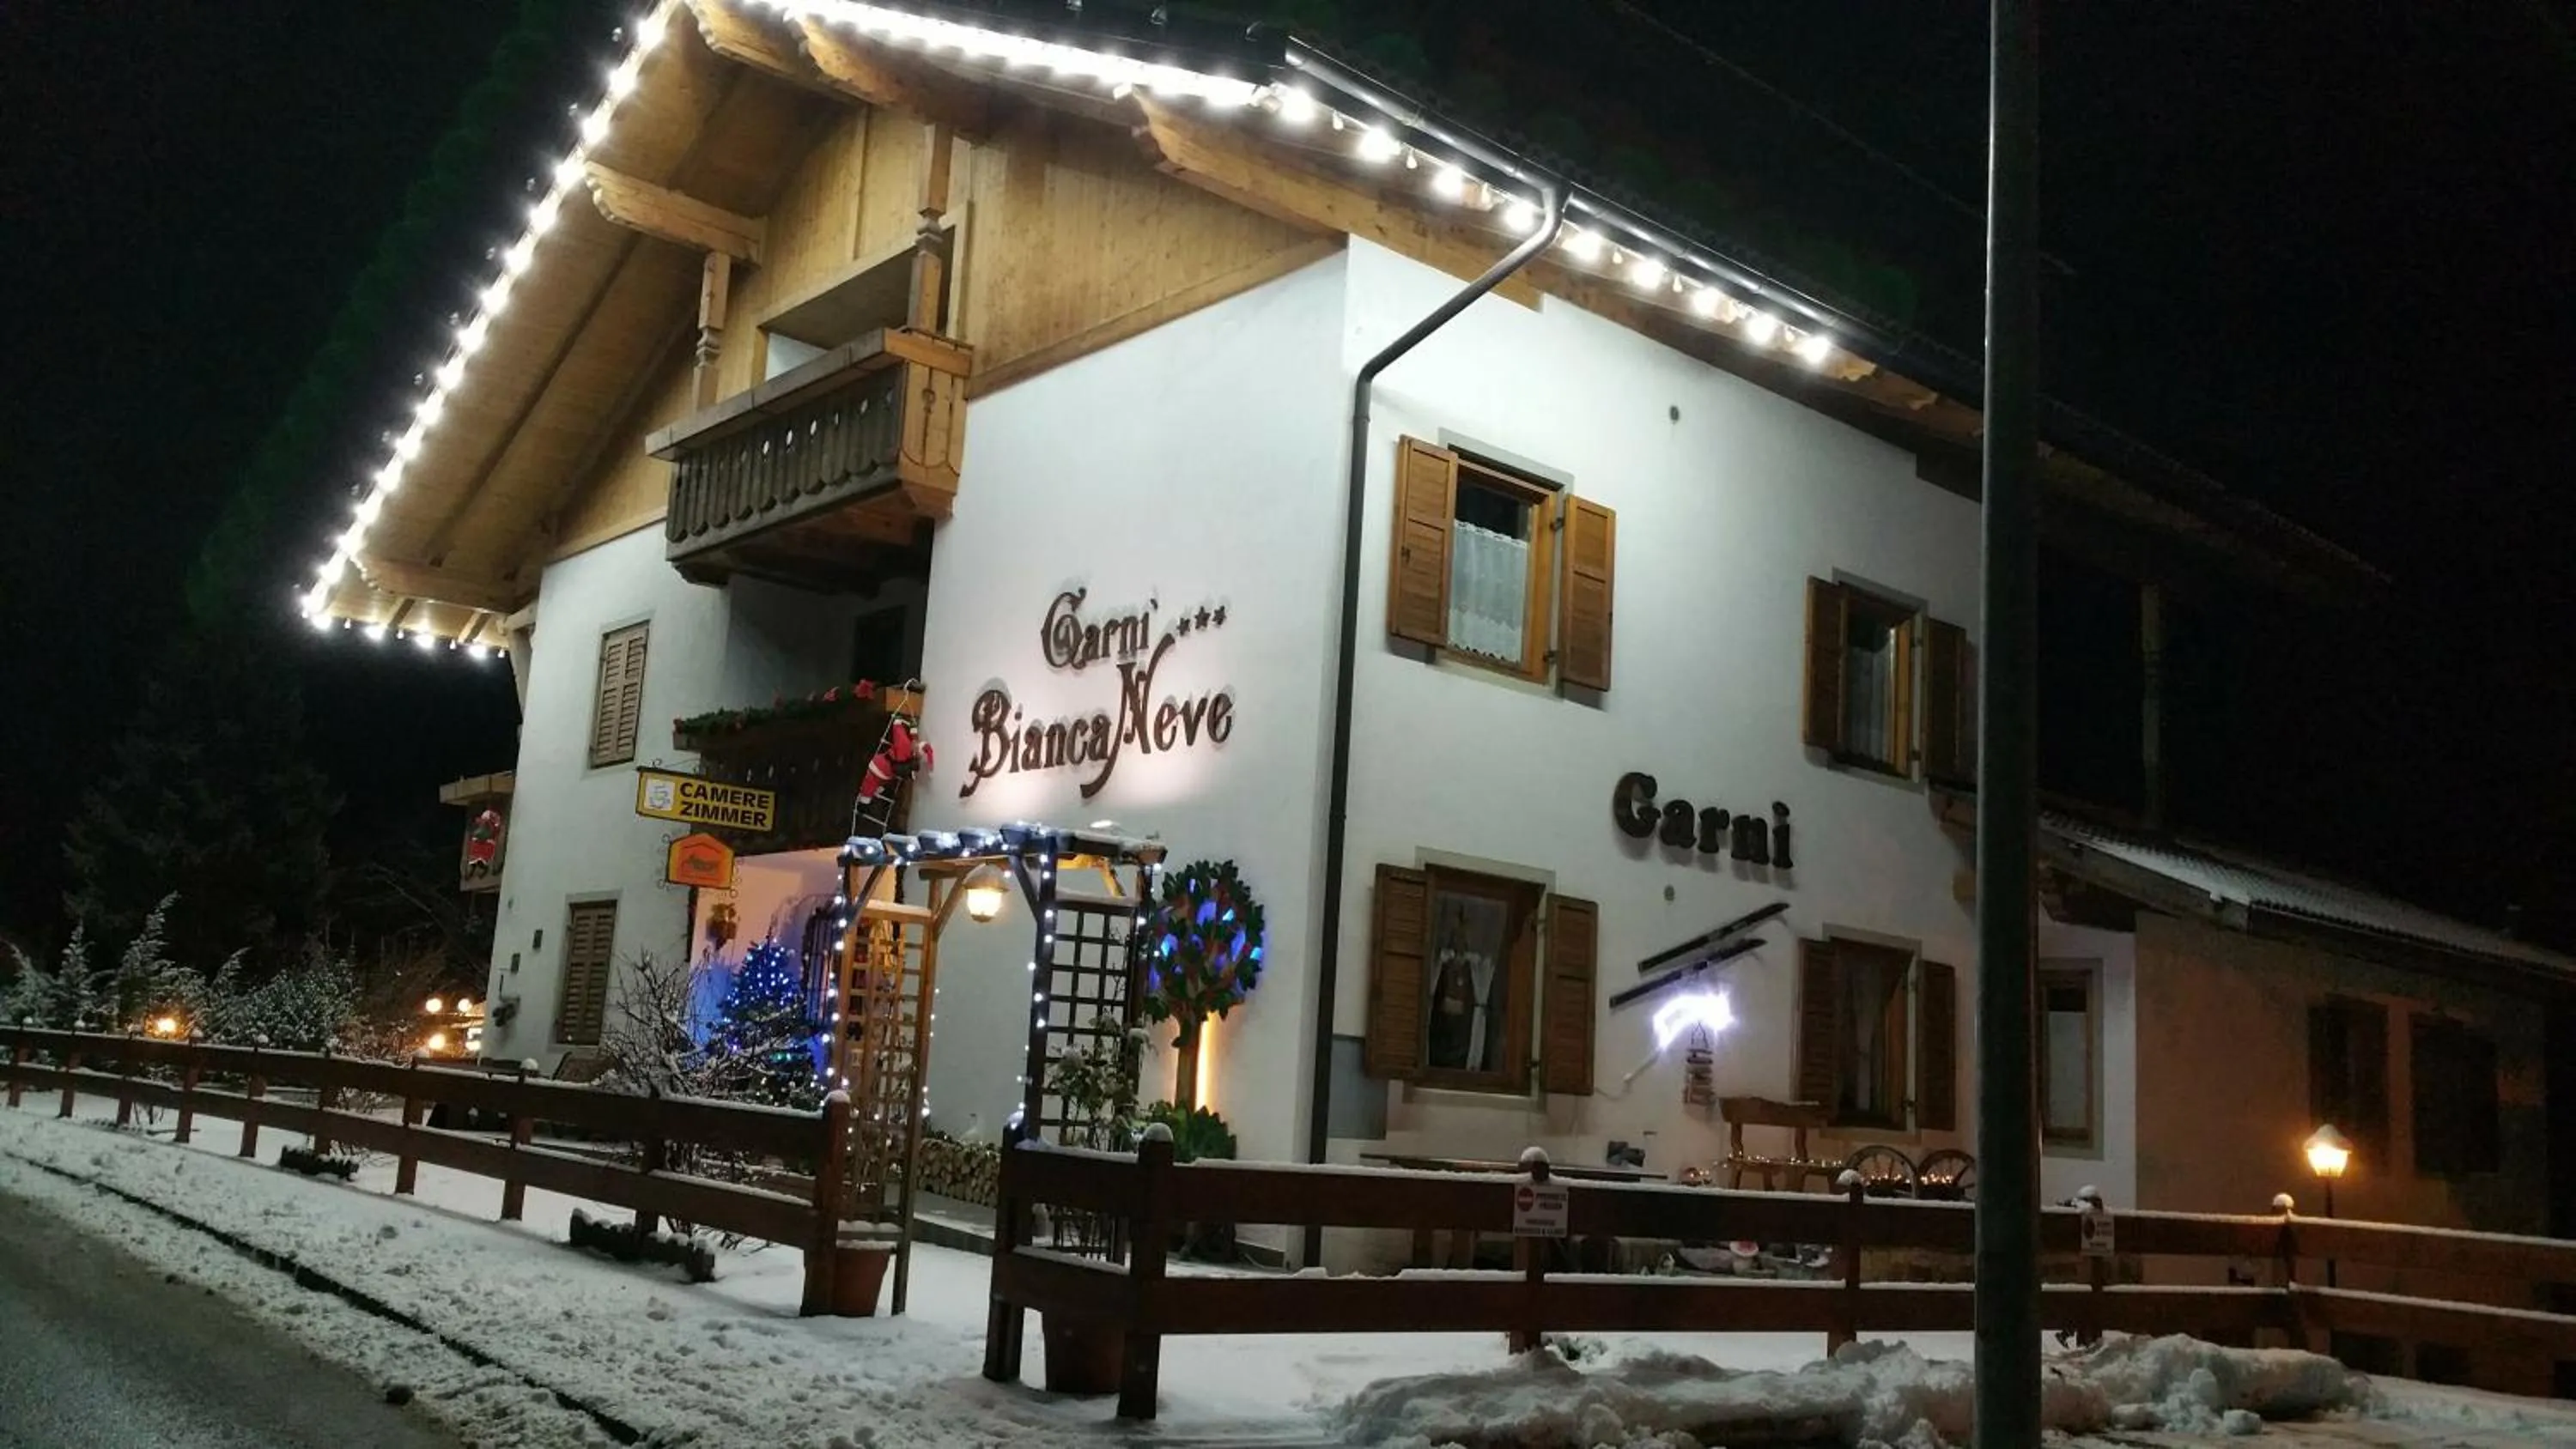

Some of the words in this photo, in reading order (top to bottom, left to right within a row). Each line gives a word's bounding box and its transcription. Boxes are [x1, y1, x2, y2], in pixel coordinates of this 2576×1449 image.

[679, 782, 770, 809] CAMERE
[679, 801, 768, 828] ZIMMER
[1613, 772, 1794, 869] Garni
